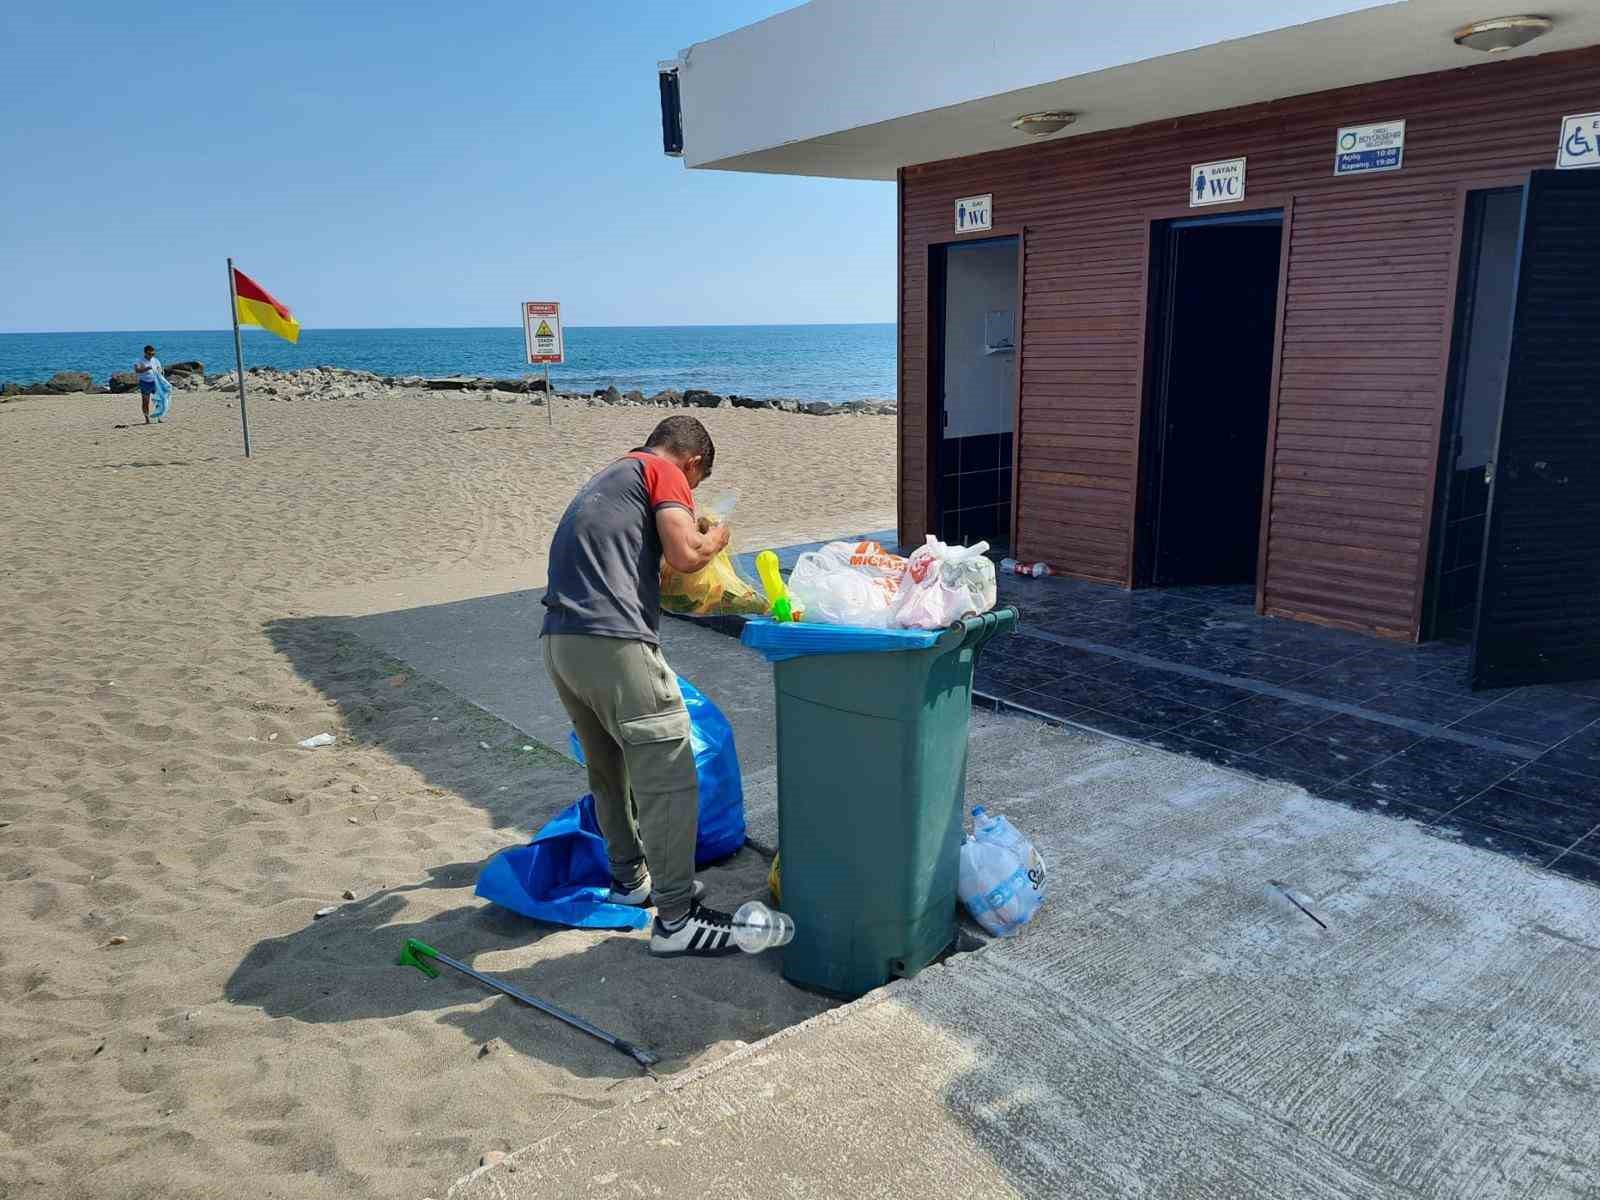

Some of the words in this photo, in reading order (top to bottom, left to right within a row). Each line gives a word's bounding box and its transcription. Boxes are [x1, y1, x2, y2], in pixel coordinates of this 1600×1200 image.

[1212, 165, 1237, 174] BAYAN
[1209, 176, 1239, 197] WC
[968, 209, 988, 225] WC
